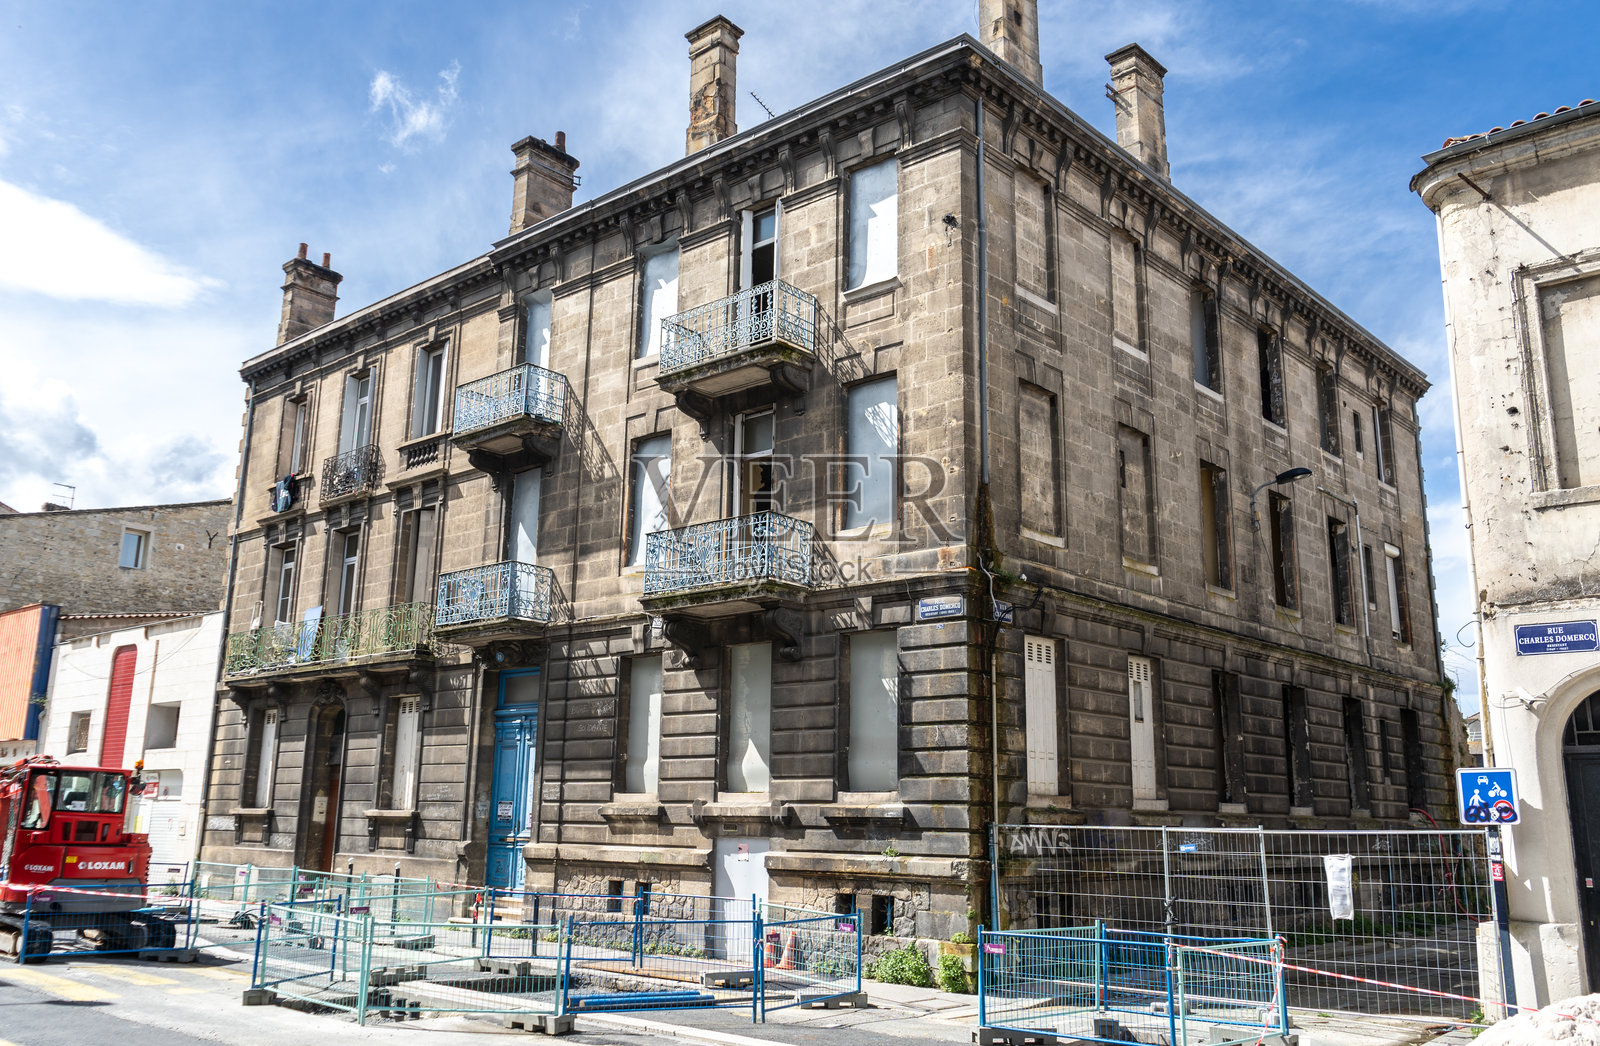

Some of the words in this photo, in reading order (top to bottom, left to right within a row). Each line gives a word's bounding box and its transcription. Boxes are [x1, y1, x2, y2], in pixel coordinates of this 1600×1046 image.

[1519, 636, 1554, 644] CHARLES
[1556, 633, 1595, 642] DOMERCQ
[29, 864, 55, 872] LOXAM
[87, 861, 126, 870] LOXAM
